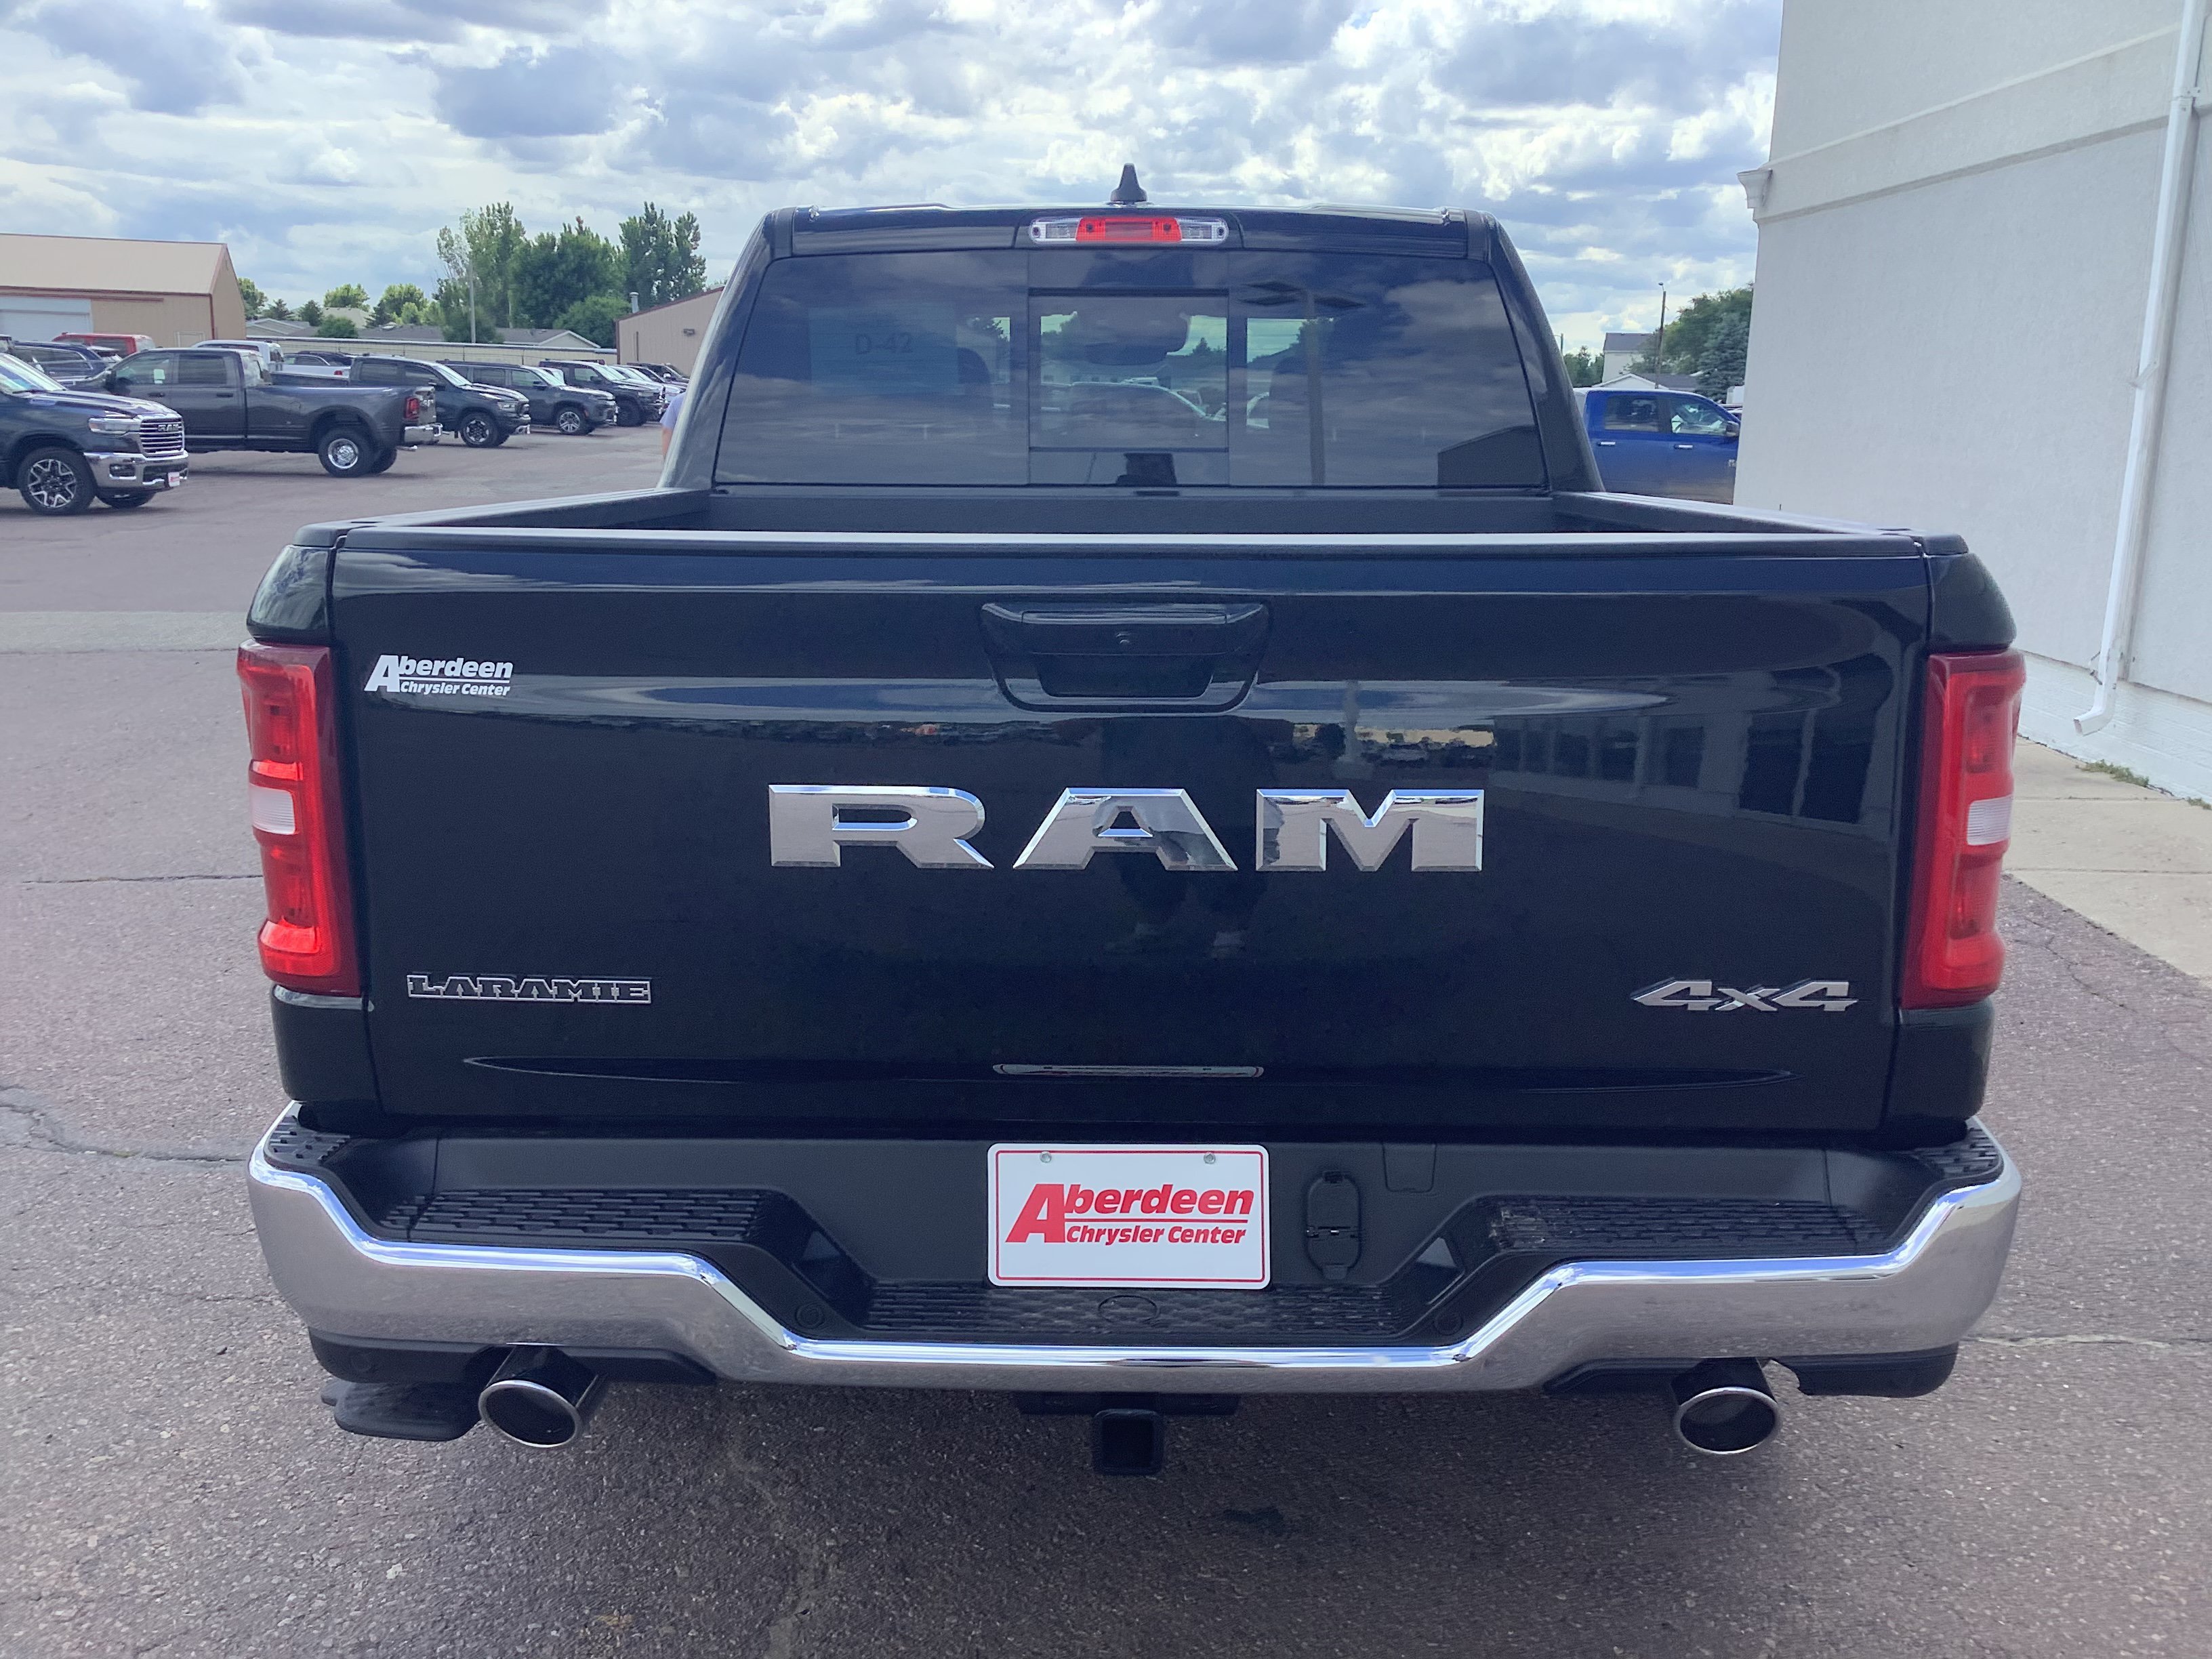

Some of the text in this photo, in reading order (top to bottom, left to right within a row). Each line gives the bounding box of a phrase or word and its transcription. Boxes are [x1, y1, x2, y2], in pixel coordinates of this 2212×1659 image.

[855, 332, 914, 354] D-42
[364, 655, 513, 692] Aberdeen
[401, 681, 510, 695] Chrysler Center
[768, 784, 1485, 872] RAM
[407, 975, 652, 1004] LARAMIE
[1631, 980, 1858, 1011] 4x4
[1005, 1184, 1254, 1243] Aberdeen
[1067, 1225, 1246, 1246] Chrysler Center
